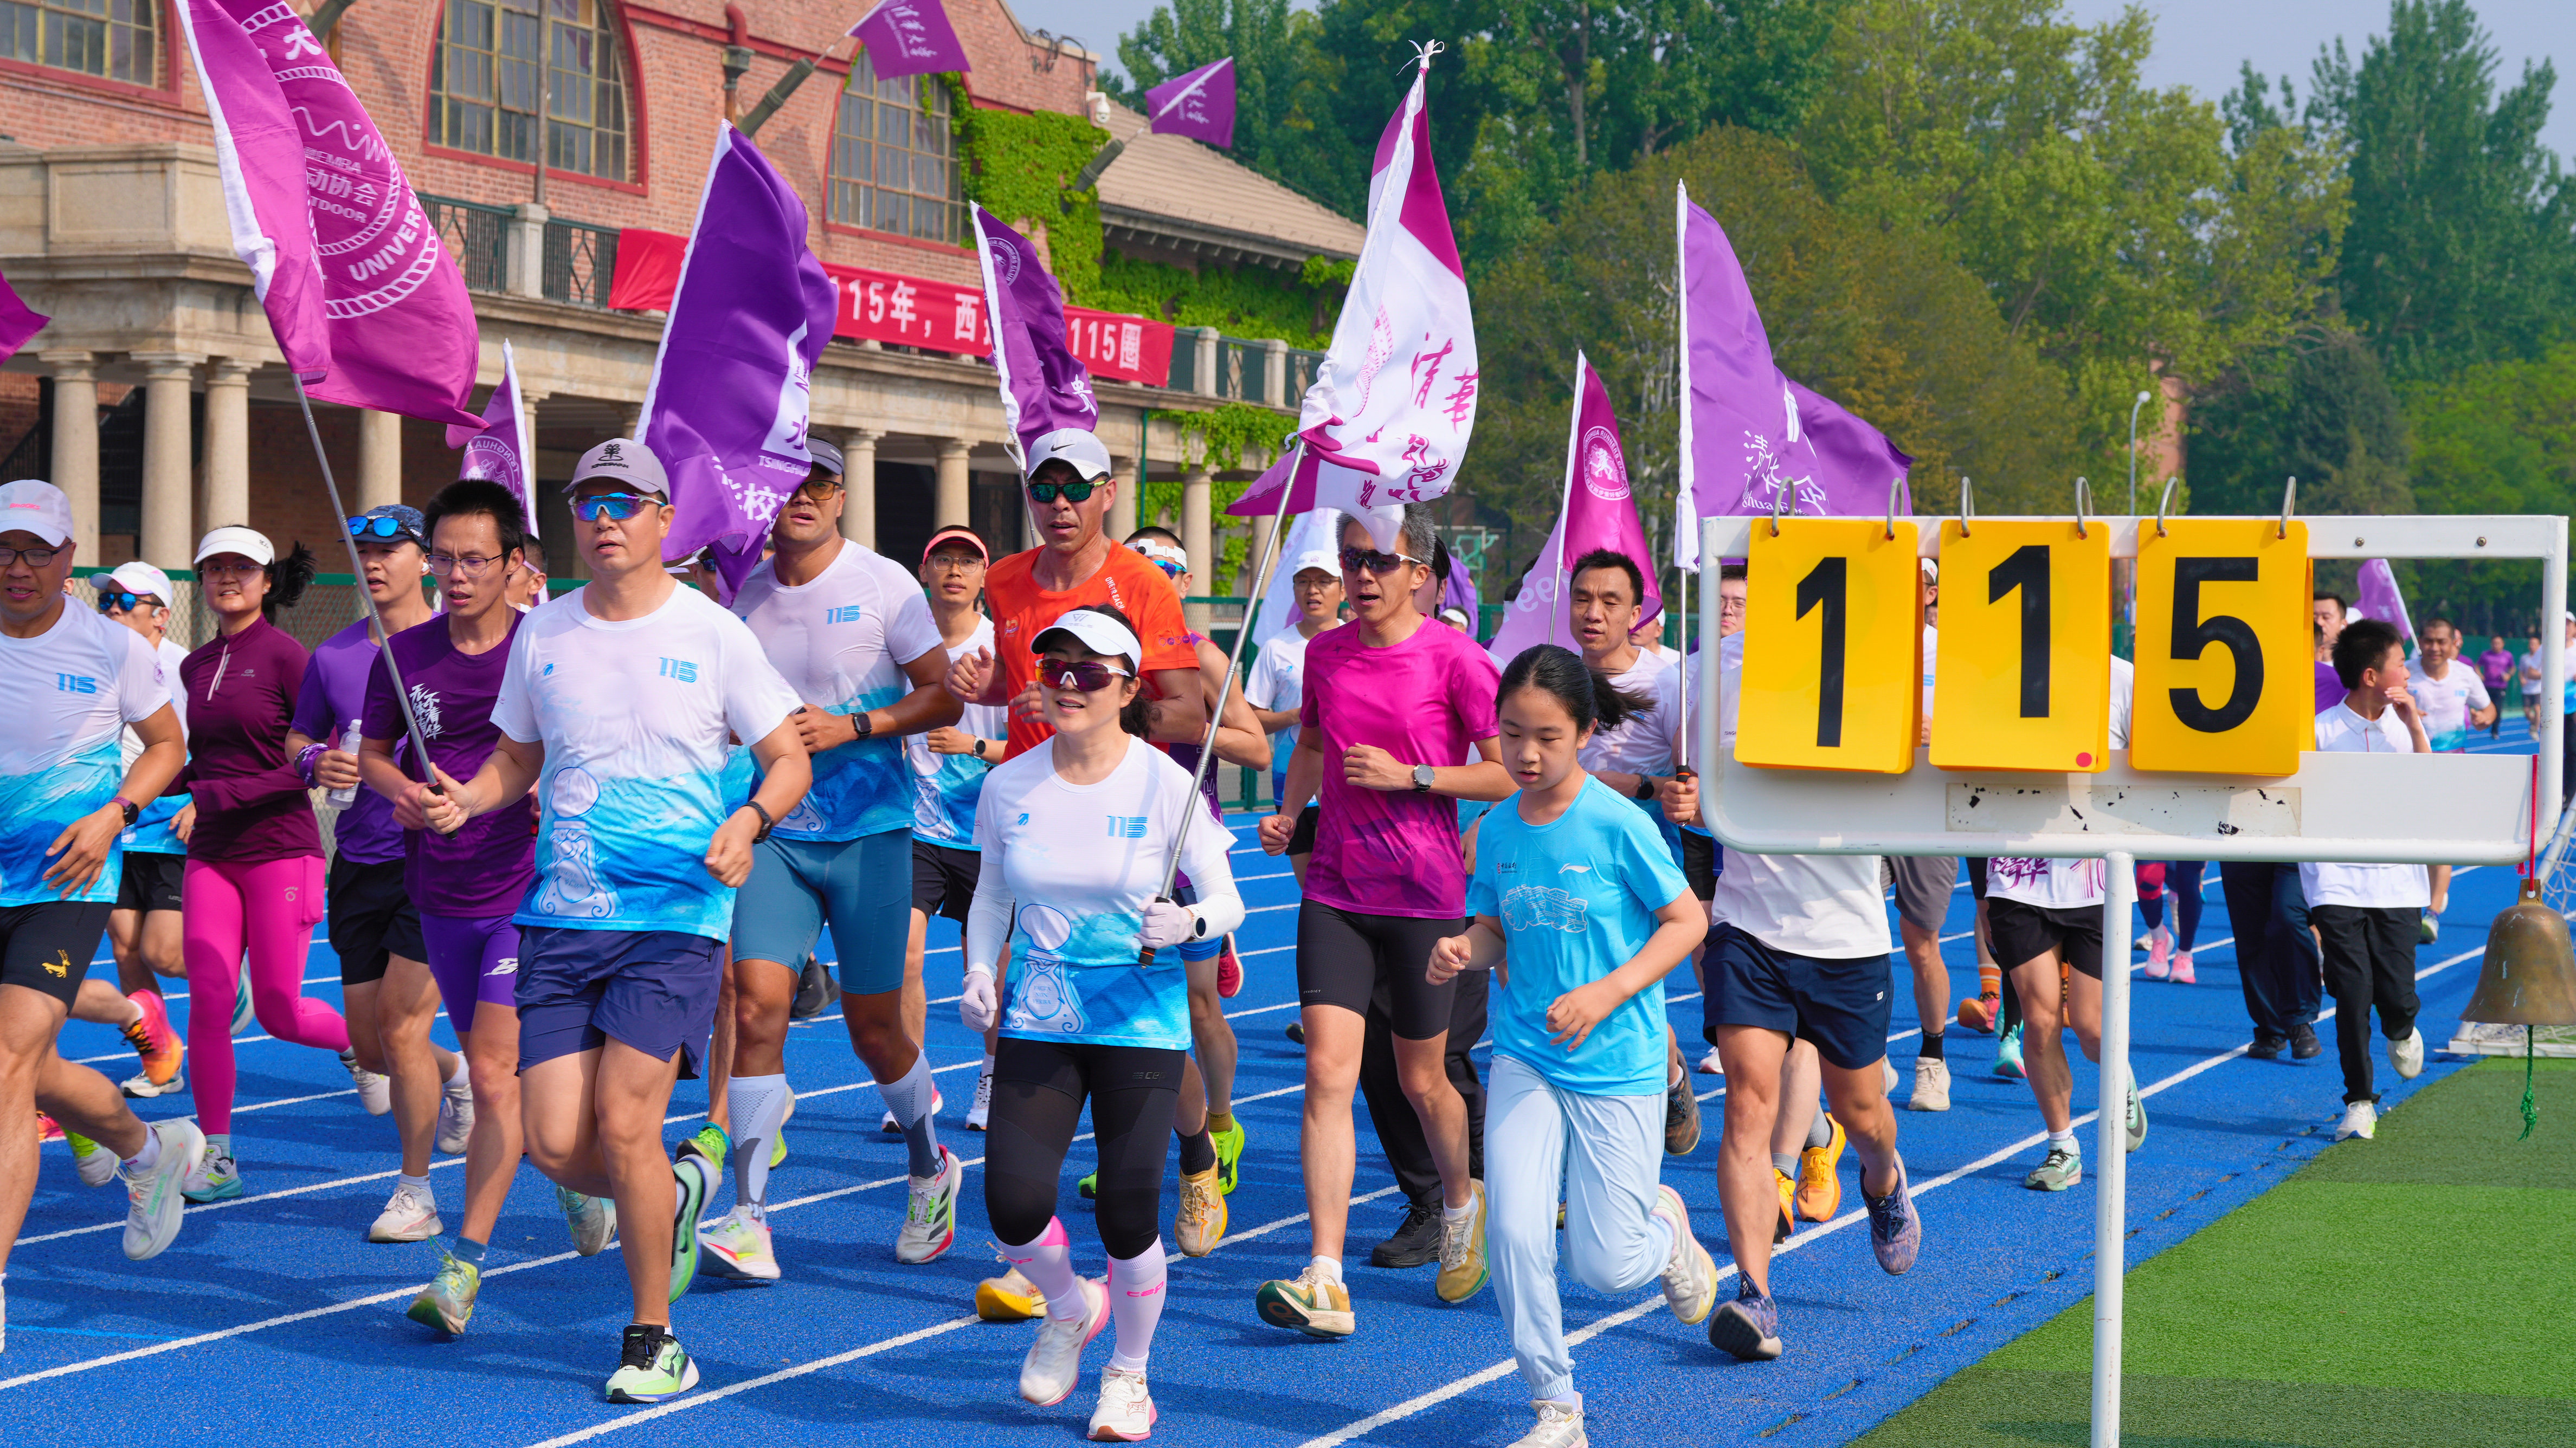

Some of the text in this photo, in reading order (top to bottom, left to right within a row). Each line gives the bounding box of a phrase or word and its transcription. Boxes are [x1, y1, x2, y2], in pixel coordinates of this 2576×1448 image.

[826, 605, 860, 625] 115
[659, 657, 699, 683] 115
[56, 673, 96, 694] 115
[1106, 815, 1148, 838] 115
[1546, 895, 1581, 909] MARATHON
